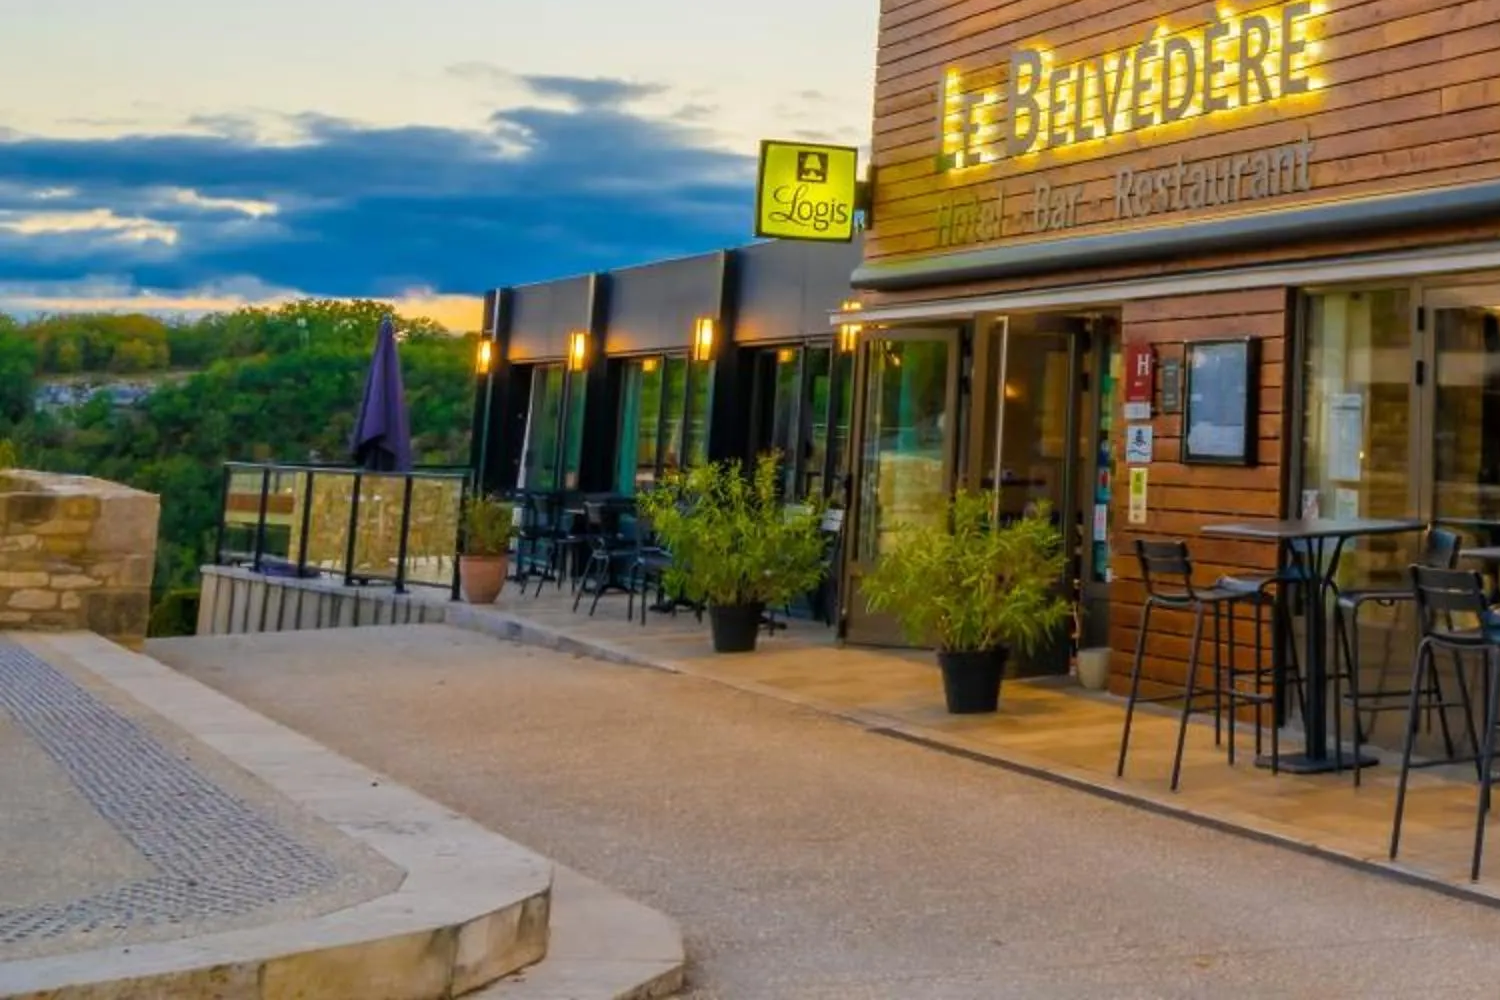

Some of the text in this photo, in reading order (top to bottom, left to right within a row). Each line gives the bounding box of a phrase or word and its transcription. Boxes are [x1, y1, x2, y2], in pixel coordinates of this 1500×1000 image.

[1006, 1, 1311, 155] BELVÉDÈRE
[768, 184, 849, 232] Logis
[1033, 176, 1083, 232] Bar
[1115, 123, 1314, 219] Restaurant
